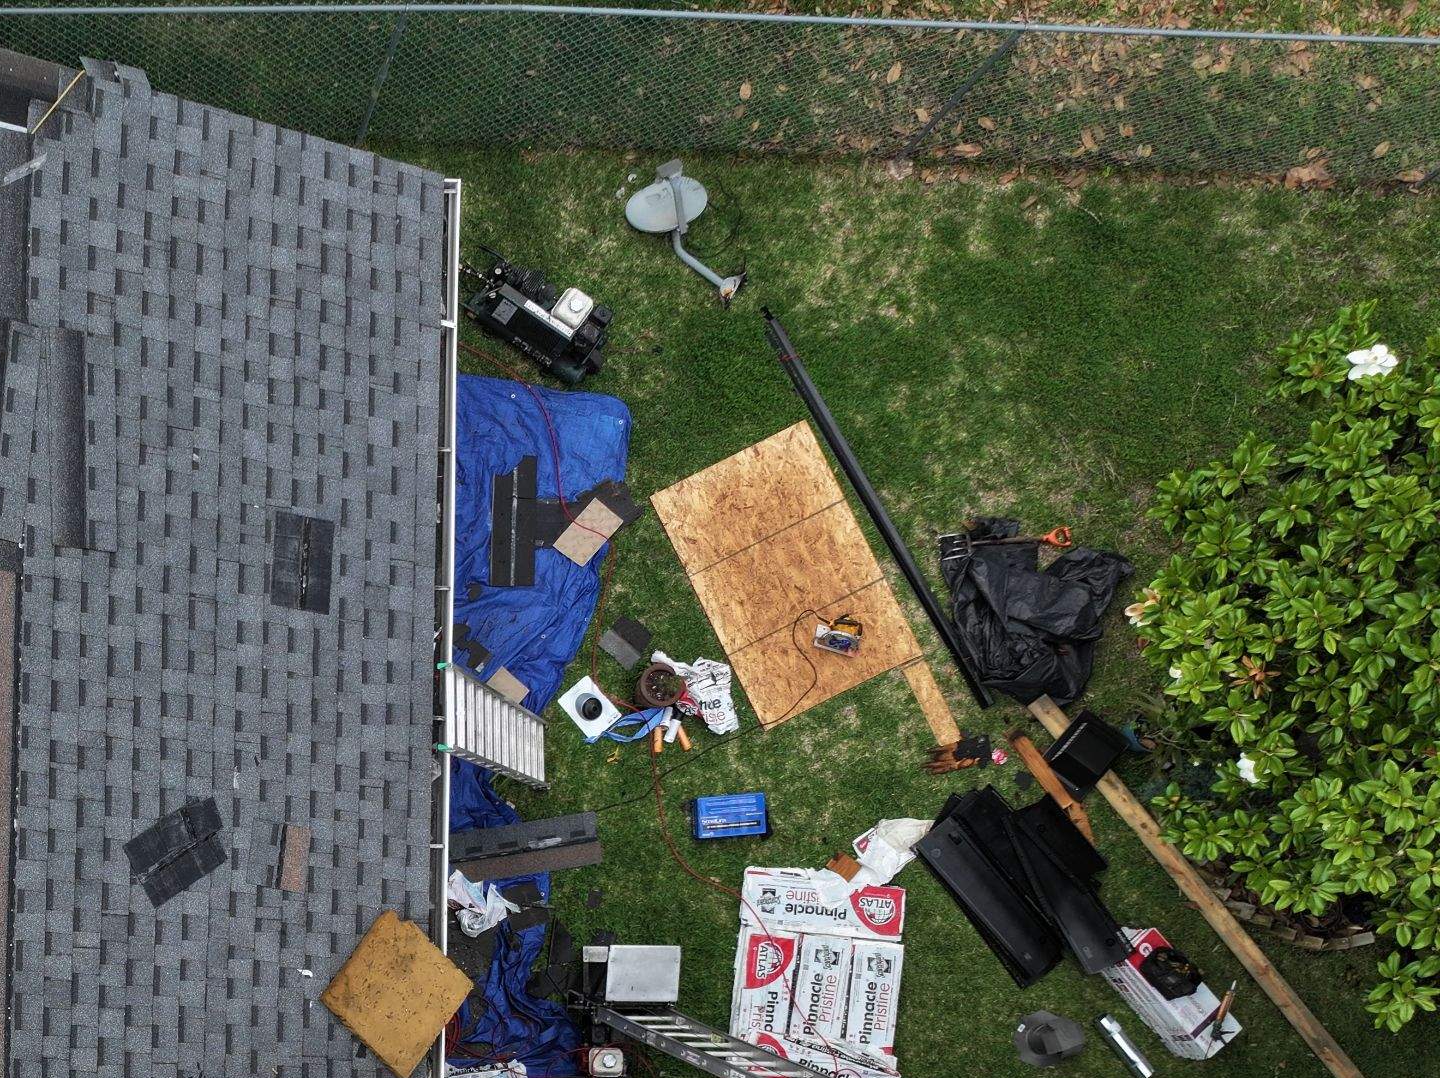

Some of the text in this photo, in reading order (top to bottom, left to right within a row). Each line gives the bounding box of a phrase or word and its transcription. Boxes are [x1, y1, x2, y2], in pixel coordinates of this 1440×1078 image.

[785, 903, 847, 921] Pinnacle
[860, 898, 892, 909] ATLAS
[758, 946, 768, 979] ATLAS
[803, 973, 824, 1036] Pinnacle
[818, 974, 837, 1023] Pristine
[859, 981, 878, 1045] Pinnacle
[874, 982, 891, 1031] Pristine
